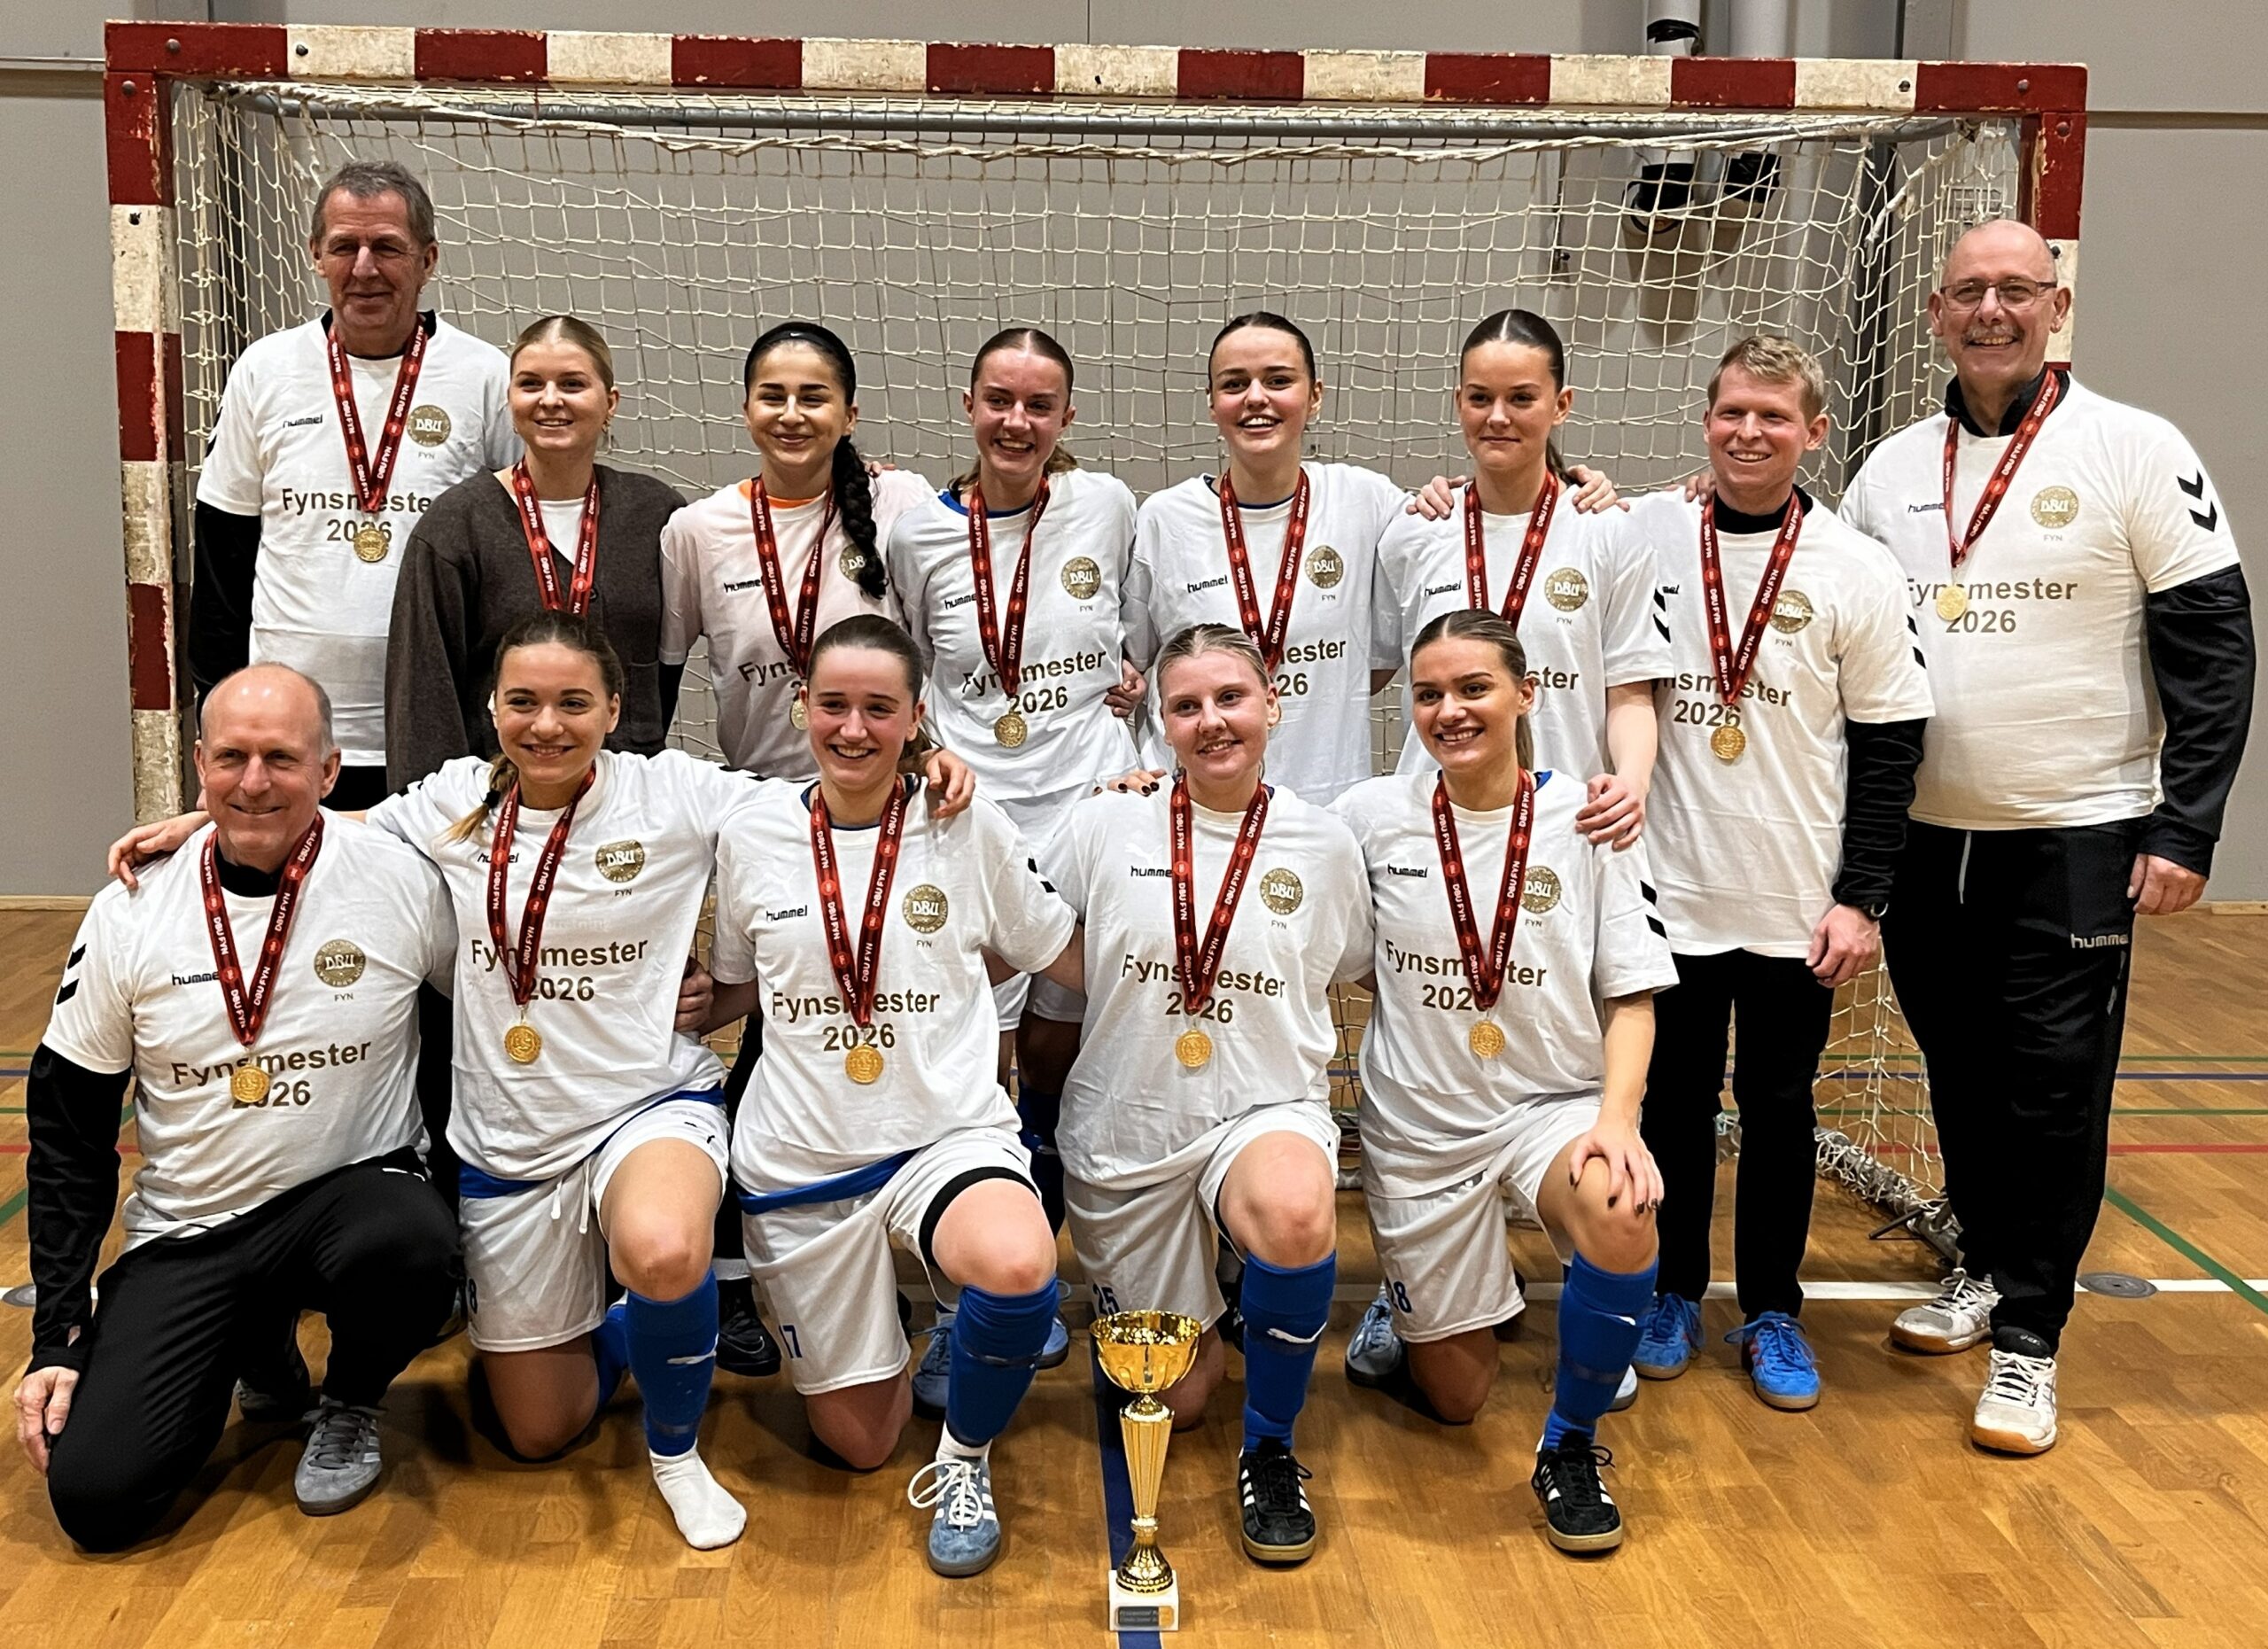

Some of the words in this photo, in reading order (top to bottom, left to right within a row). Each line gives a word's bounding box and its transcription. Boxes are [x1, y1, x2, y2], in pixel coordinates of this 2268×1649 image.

[416, 418, 442, 432] DBU
[283, 488, 433, 516] Fynsmste
[1907, 502, 1945, 513] humme
[2039, 499, 2069, 513] DBU
[848, 556, 866, 570] DB
[1313, 559, 1335, 573] DBU
[724, 579, 763, 593] humme
[1069, 570, 1093, 585] DBU
[1187, 575, 1228, 594] hummel
[1425, 580, 1462, 597] hummel
[1553, 581, 1581, 596] DBU
[944, 593, 977, 610] humme
[1775, 639, 1792, 648] FYN
[961, 650, 1107, 696] Fynmester
[888, 815, 897, 836] DBU
[1438, 813, 1447, 834] DBU
[1518, 808, 1527, 827] DBU
[1247, 820, 1257, 838] DBU
[816, 830, 827, 852] DBU
[1442, 833, 1451, 851] FYN
[478, 852, 519, 863] huel
[606, 852, 636, 865] DBU
[820, 851, 829, 869] FYN
[538, 870, 549, 891] DBU
[544, 852, 555, 871] FYN
[876, 869, 887, 887] FYN
[1130, 866, 1172, 878] humme
[1387, 863, 1428, 877] hummel
[1511, 860, 1520, 879] FYN
[872, 886, 883, 907] DBU
[1224, 885, 1236, 905] DBU
[1231, 869, 1242, 887] FYN
[1269, 883, 1294, 900] DBU
[1453, 883, 1463, 903] DBU
[1507, 878, 1517, 898] DBU
[1524, 880, 1551, 898] DBU
[279, 892, 291, 912] FYN
[827, 901, 837, 922] DBU
[912, 901, 938, 915] DBU
[275, 911, 286, 932] DBU
[766, 905, 808, 922] hummel
[1457, 903, 1466, 922] FYN
[214, 916, 225, 938] DBU
[830, 921, 840, 940] FYN
[1271, 920, 1286, 930] FYN
[218, 936, 229, 955] FYN
[2070, 933, 2129, 948] humme
[324, 953, 355, 970] DBU
[471, 939, 649, 972] Fynmester
[1386, 939, 1547, 987] Fynsmter
[172, 972, 220, 986] humme
[862, 961, 871, 983] DBU
[1122, 954, 1285, 998] Fynsester
[230, 989, 241, 1008] DBU
[253, 984, 265, 1006] DBU
[1422, 984, 1477, 1011] 202
[773, 989, 940, 1023] Fynsester
[1165, 992, 1234, 1023] 226
[823, 1023, 895, 1052] 2026
[1092, 1283, 1121, 1315] 25
[779, 1326, 803, 1358] 17
